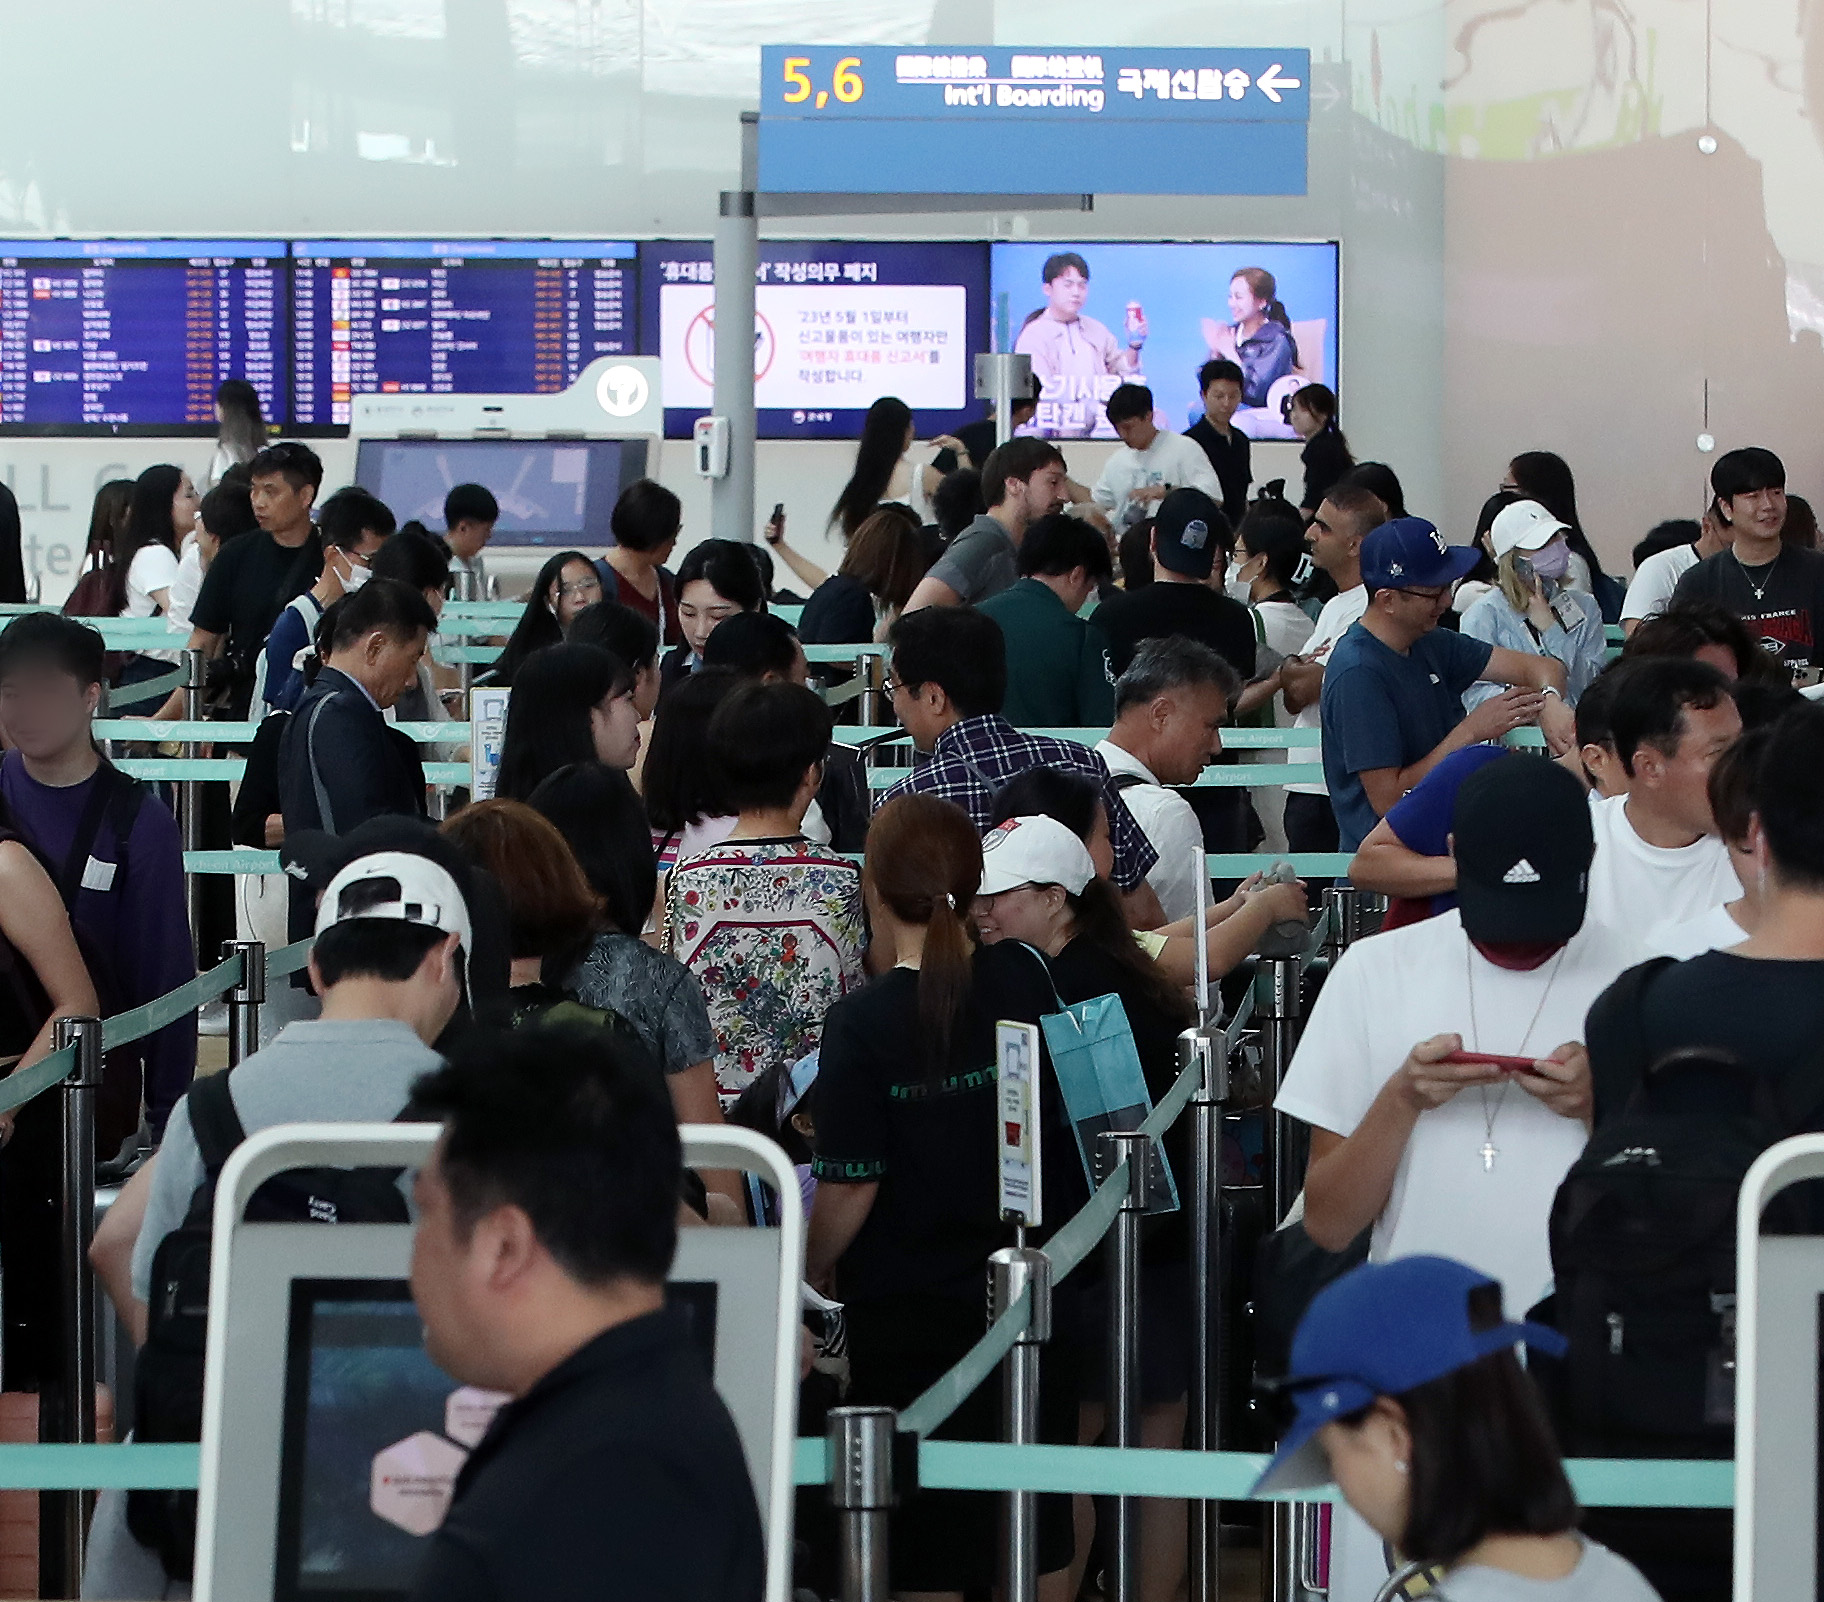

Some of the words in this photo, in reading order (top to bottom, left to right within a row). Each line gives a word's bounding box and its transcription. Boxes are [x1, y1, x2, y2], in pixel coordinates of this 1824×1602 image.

[783, 56, 864, 109] 5,6
[944, 83, 992, 106] Int'l
[996, 83, 1105, 113] Boarding
